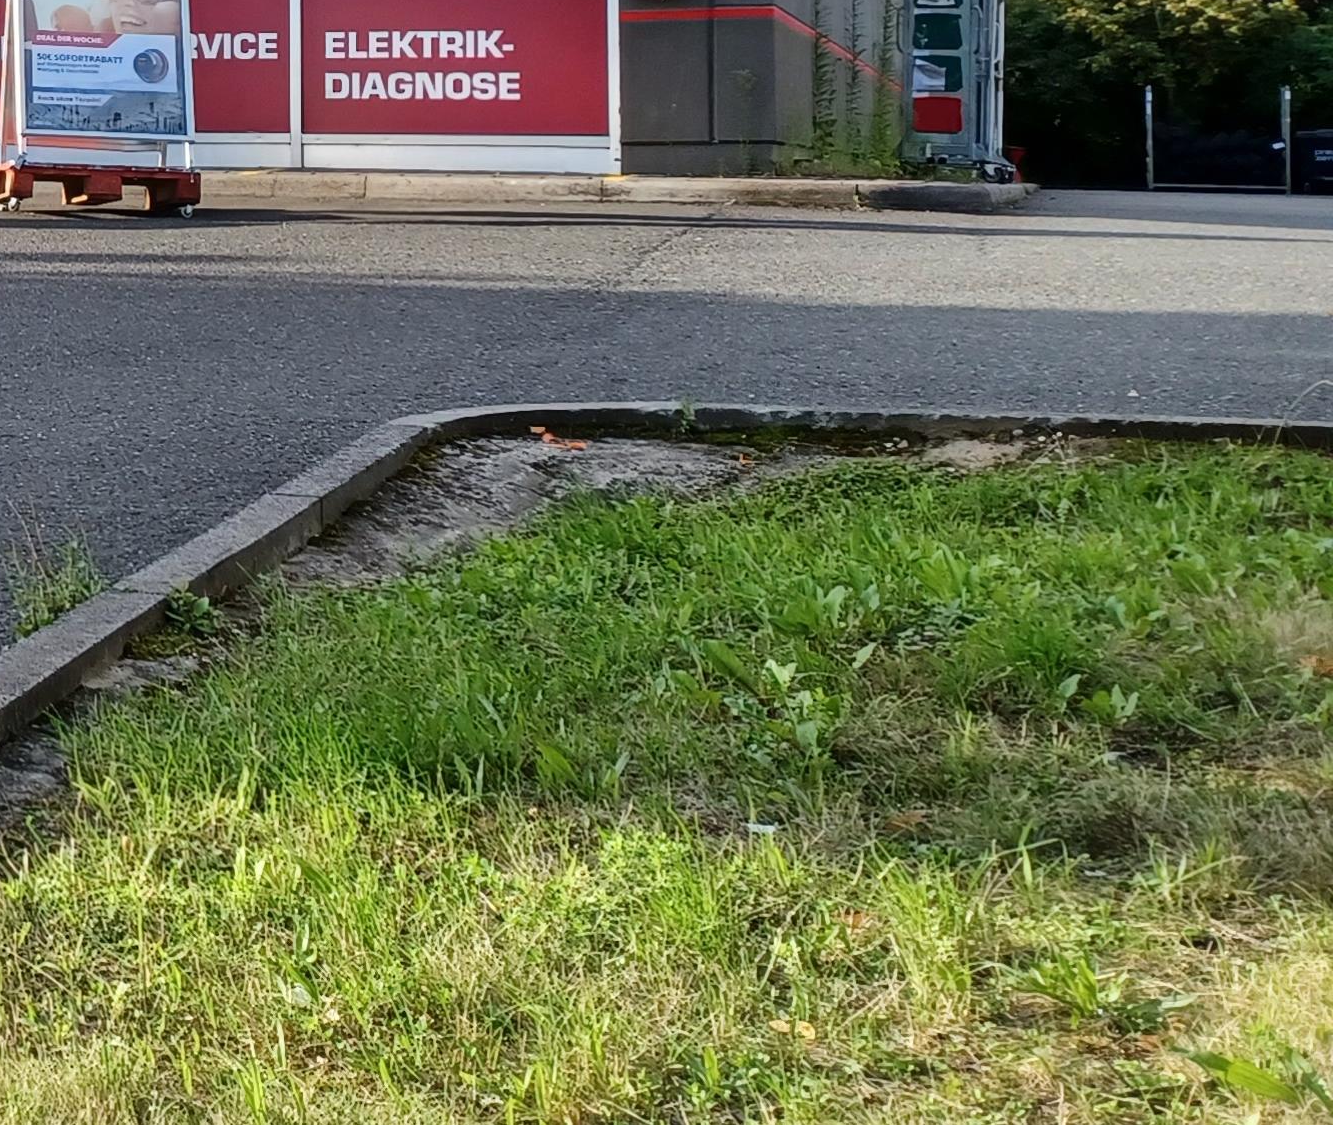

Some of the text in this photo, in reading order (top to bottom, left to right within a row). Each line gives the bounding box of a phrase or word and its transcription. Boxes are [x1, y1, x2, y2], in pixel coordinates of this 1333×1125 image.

[325, 30, 514, 59] ELEKTRIK-
[54, 54, 124, 64] SOFORTRABATT
[325, 72, 521, 100] DIAGNOSE
